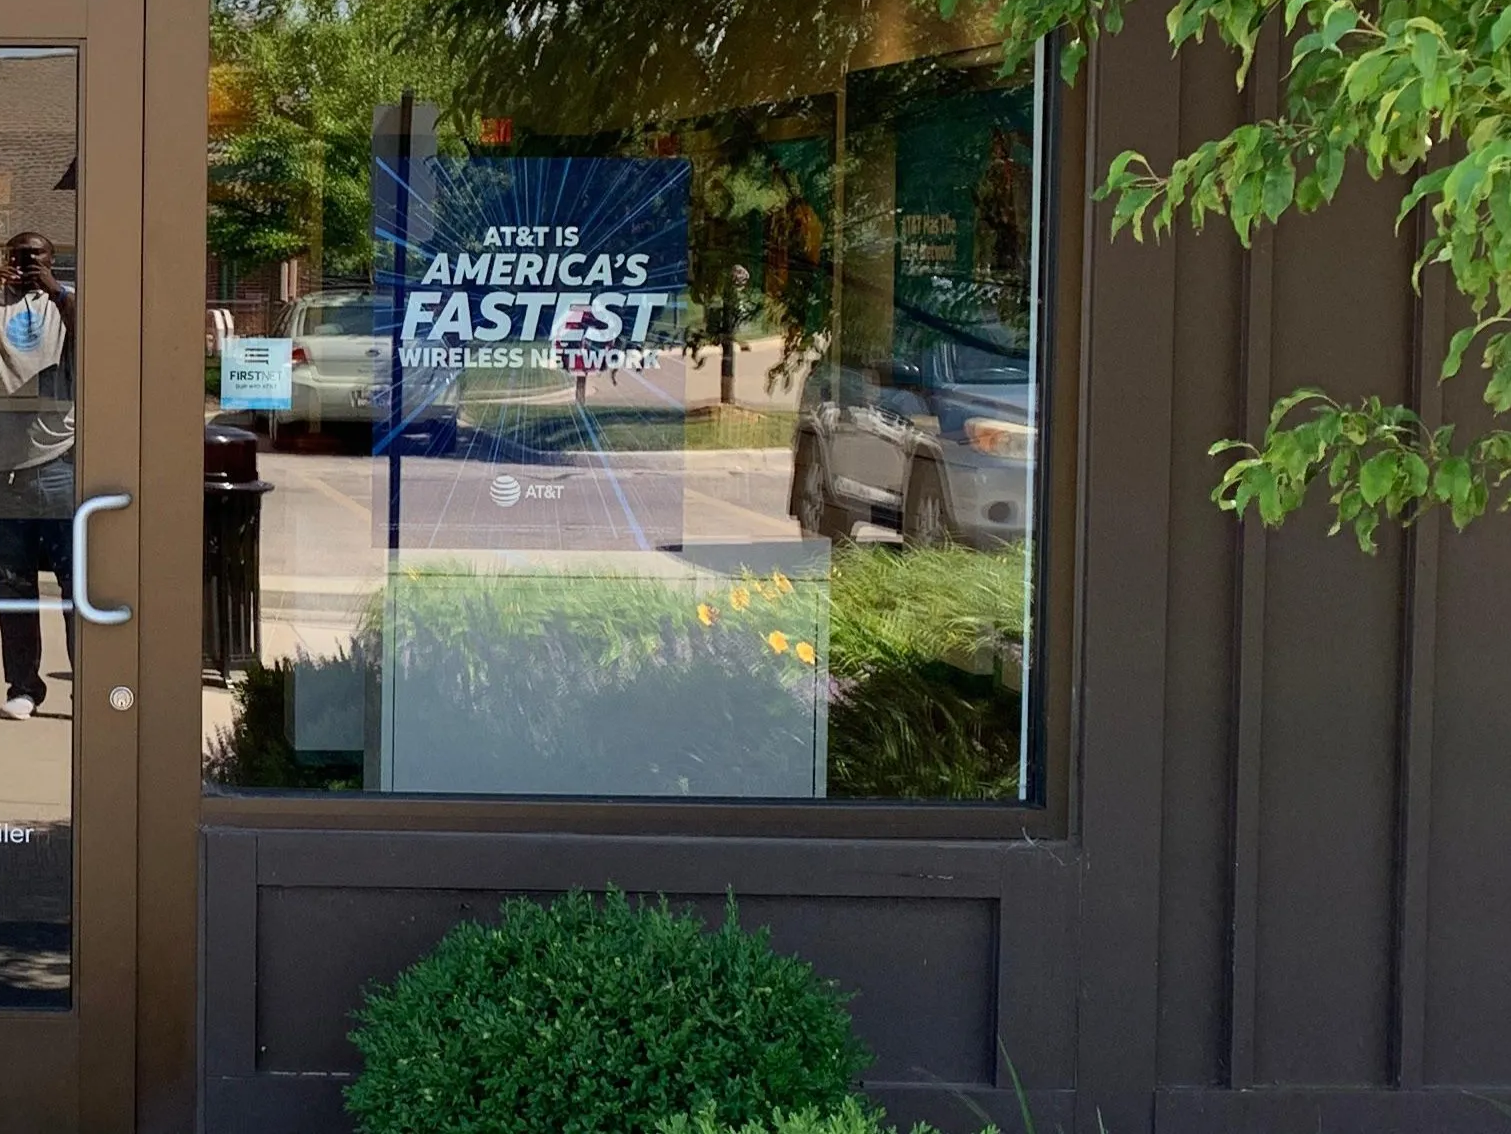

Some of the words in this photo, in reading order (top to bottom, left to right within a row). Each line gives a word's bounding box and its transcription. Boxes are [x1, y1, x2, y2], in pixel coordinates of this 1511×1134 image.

[483, 226, 549, 247] AT&T
[556, 226, 579, 247] IS
[421, 253, 649, 286] AMERICA'S
[400, 291, 668, 342] FASTEST
[398, 347, 524, 367] WIRELESS
[532, 348, 661, 369] NETWORK
[229, 370, 283, 381] FIRSTNET
[524, 485, 565, 499] AT&T
